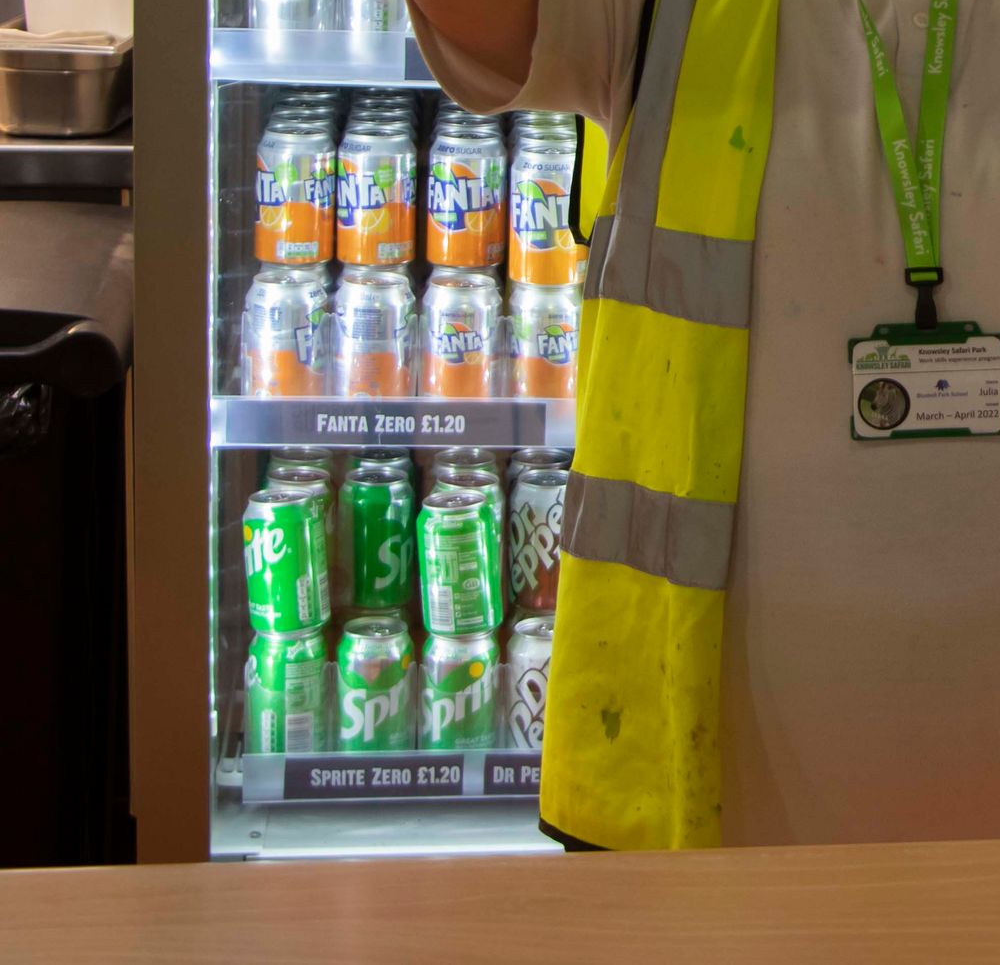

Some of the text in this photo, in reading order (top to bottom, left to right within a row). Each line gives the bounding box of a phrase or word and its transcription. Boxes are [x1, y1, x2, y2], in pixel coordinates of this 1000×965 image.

[927, 13, 952, 75] Knowsley
[870, 36, 889, 77] Safari
[455, 146, 483, 156] SUGAR
[918, 138, 936, 180] Safari
[892, 138, 919, 209] Knowsley
[908, 211, 930, 256] Safari
[918, 346, 987, 356] Knowsley Safari Park
[978, 386, 999, 397] Julia
[317, 413, 466, 434] FANTA ZERO £1.20
[916, 411, 945, 421] March
[954, 409, 976, 421] April
[977, 409, 1000, 419] 2022
[310, 765, 461, 787] SPRITE ZERO £1.20
[493, 765, 515, 784] DR
